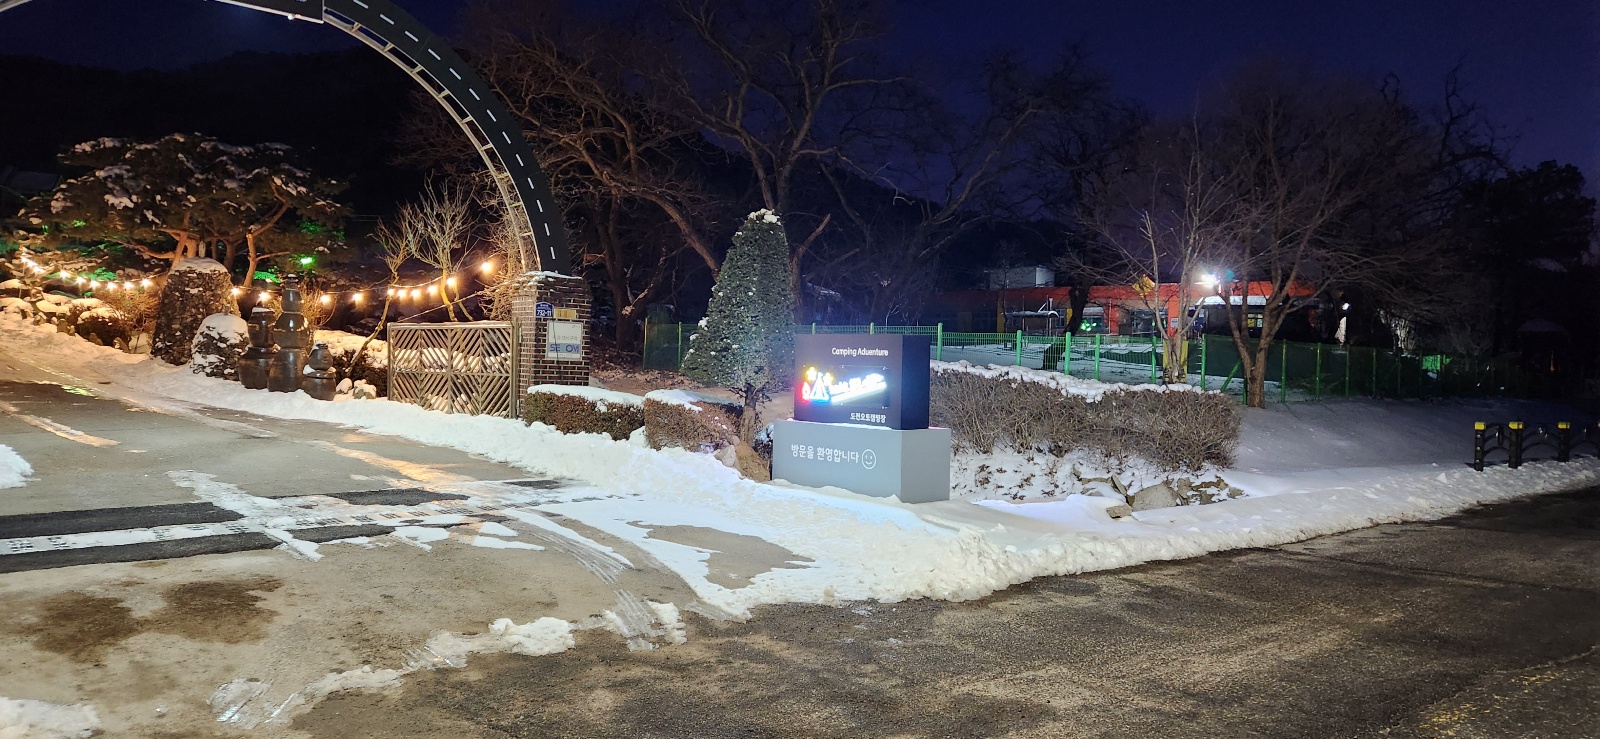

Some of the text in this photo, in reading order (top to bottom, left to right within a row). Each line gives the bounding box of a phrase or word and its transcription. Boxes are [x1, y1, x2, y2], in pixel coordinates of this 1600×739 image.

[550, 344, 579, 353] SEOM
[831, 347, 857, 357] Camping
[791, 444, 860, 464] 방문을 환영합니다
